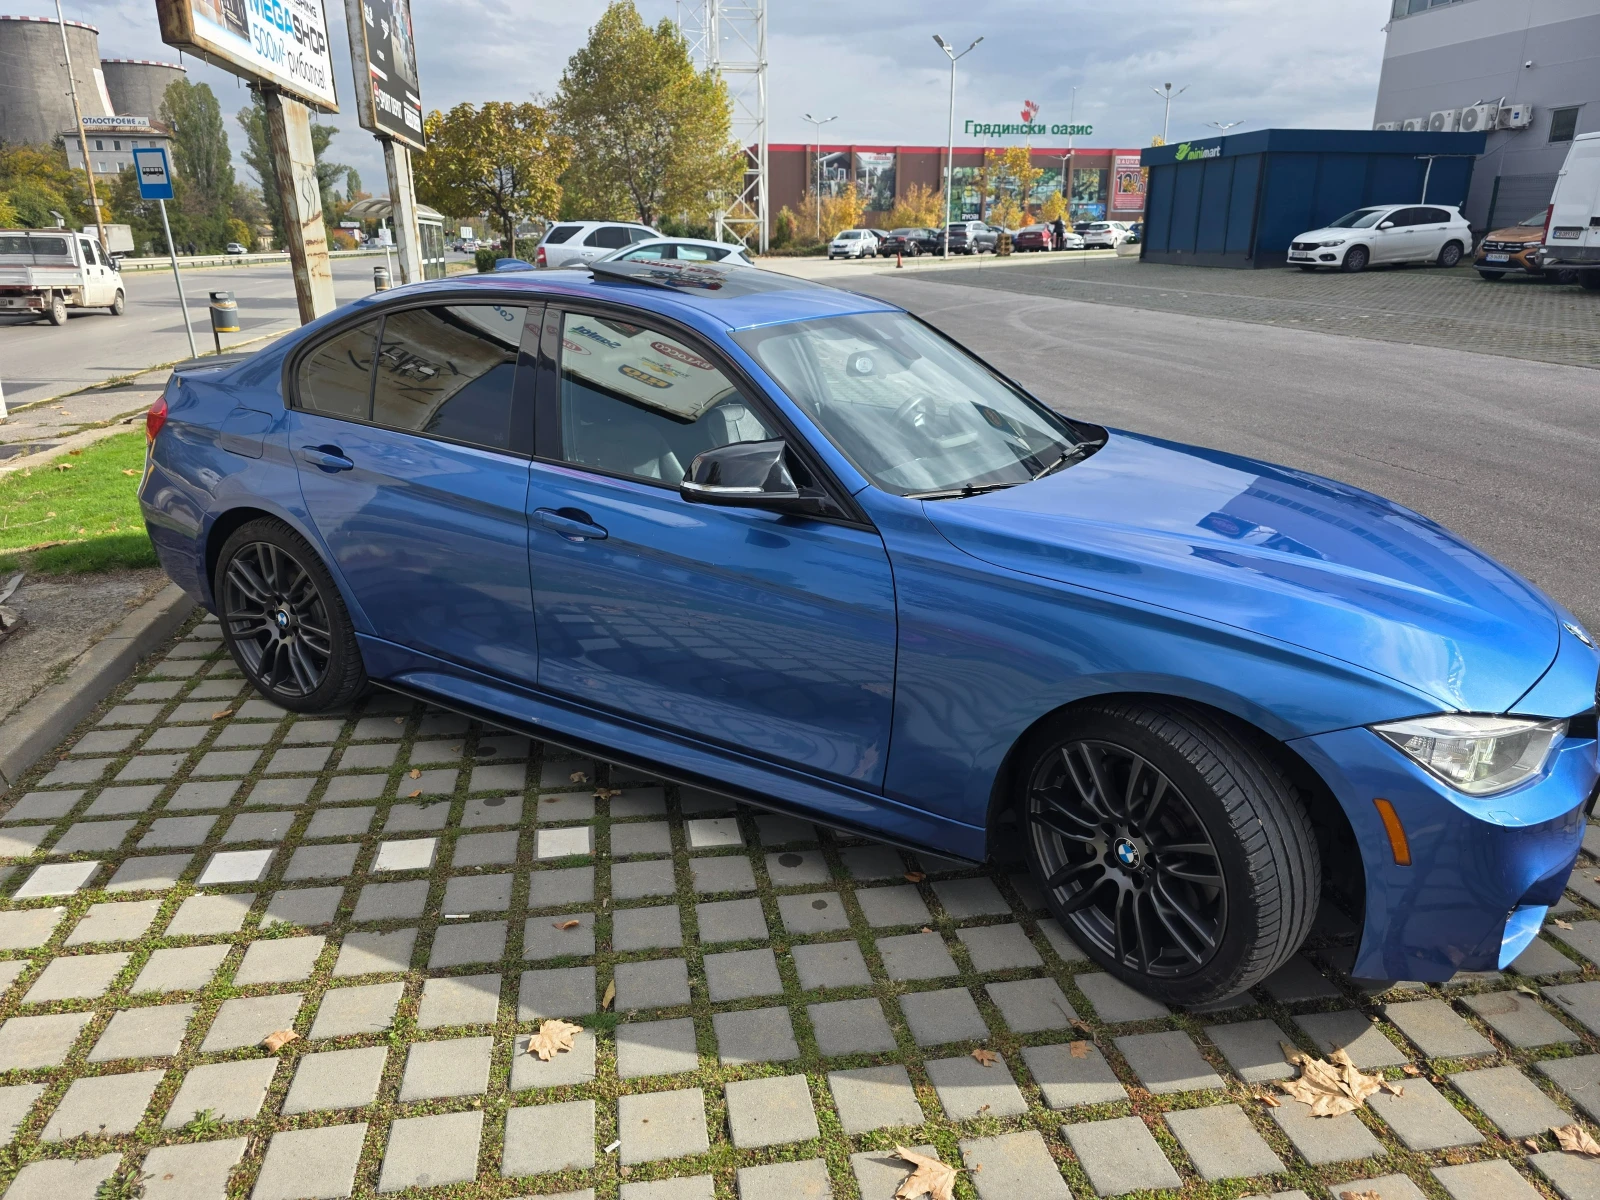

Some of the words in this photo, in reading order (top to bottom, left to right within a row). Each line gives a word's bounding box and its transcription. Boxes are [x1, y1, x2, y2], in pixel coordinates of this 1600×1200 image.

[81, 117, 136, 125] ОТЛОСТРОЕНЕ
[964, 120, 1046, 137] Градински
[1051, 123, 1094, 136] оазис
